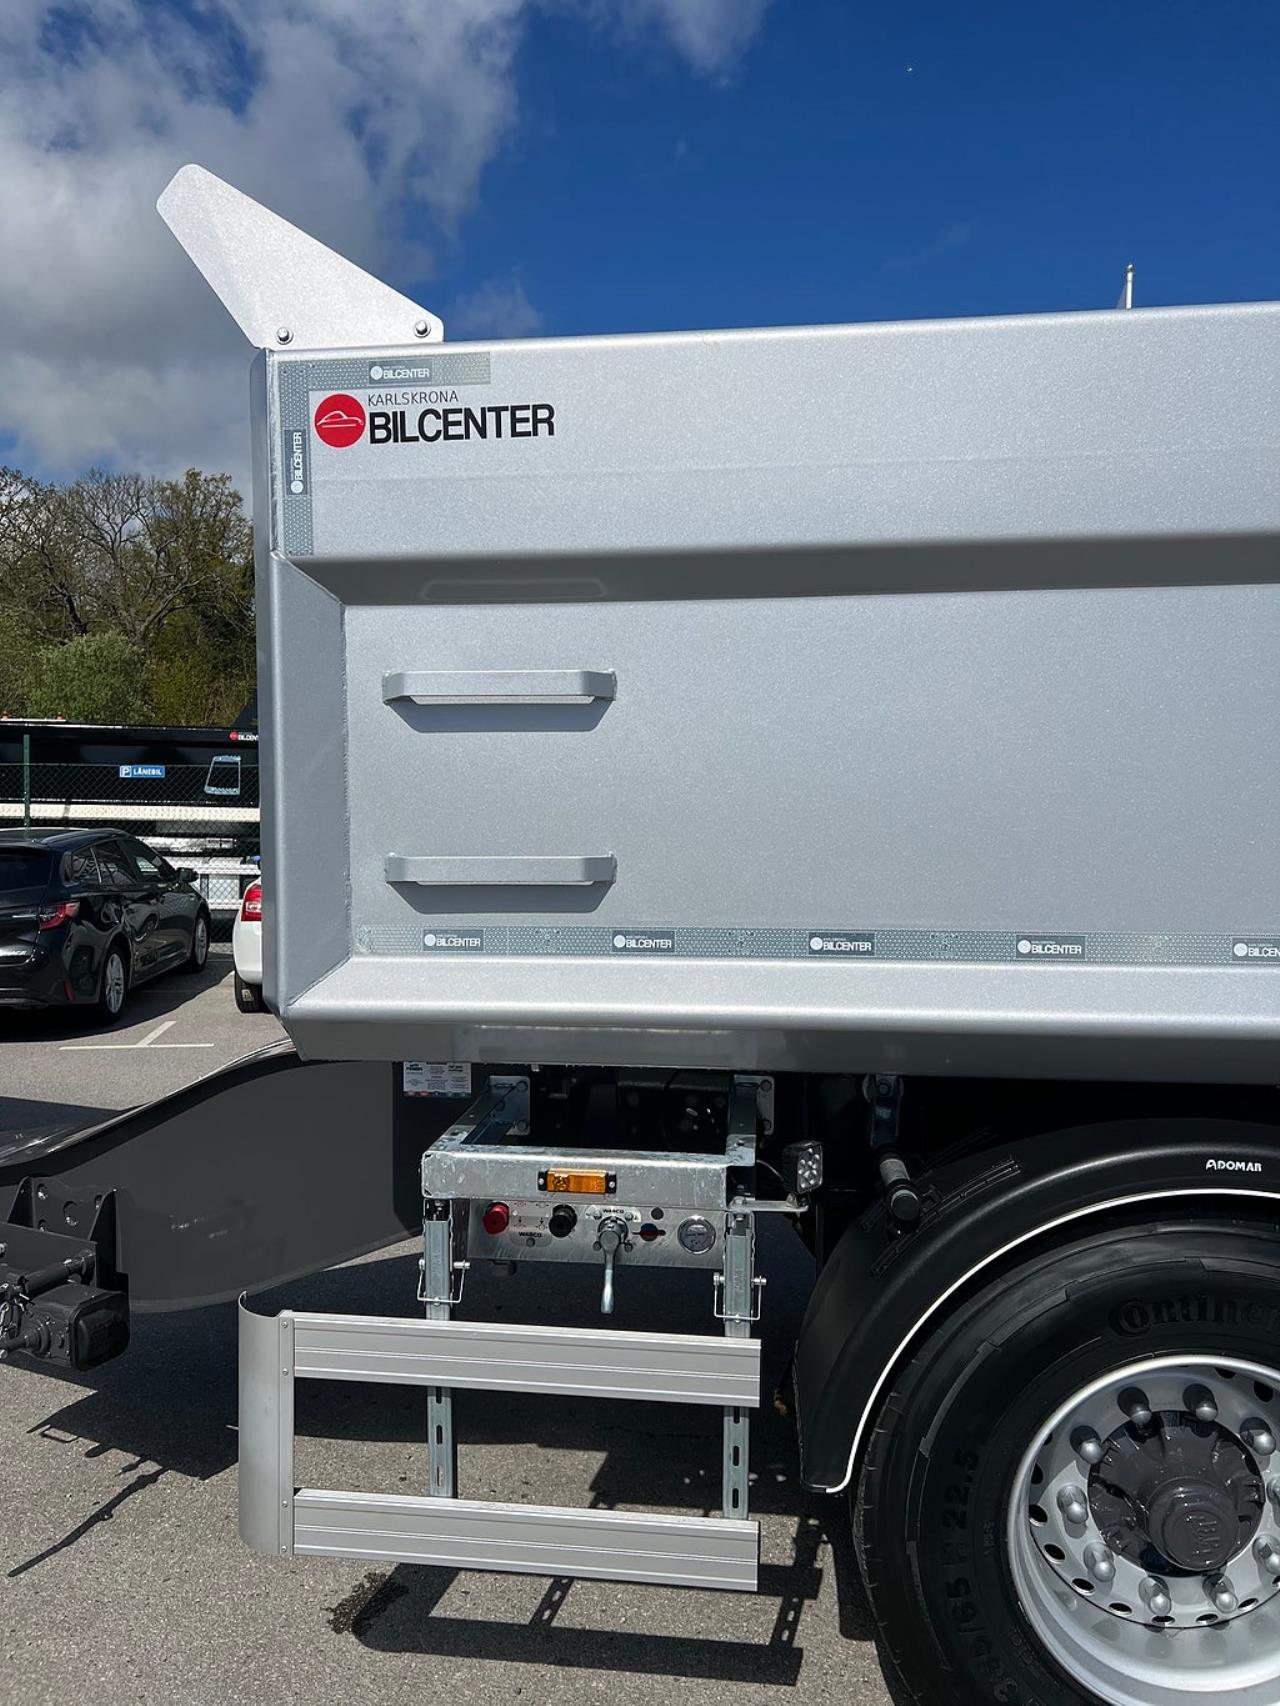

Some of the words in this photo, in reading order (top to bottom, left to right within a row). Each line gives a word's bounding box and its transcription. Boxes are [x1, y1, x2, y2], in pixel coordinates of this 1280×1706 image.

[382, 367, 430, 380] BILCENTER
[367, 390, 459, 407] KARLSKRONA
[369, 403, 556, 444] BILCENTER
[293, 431, 303, 481] BILCENTER
[436, 937, 481, 947] BILCENTER
[625, 939, 672, 949] BILCENTER
[823, 940, 872, 951] BILCENTER
[1032, 944, 1082, 955] BILCENTER
[1205, 1159, 1262, 1172] ADOMAR
